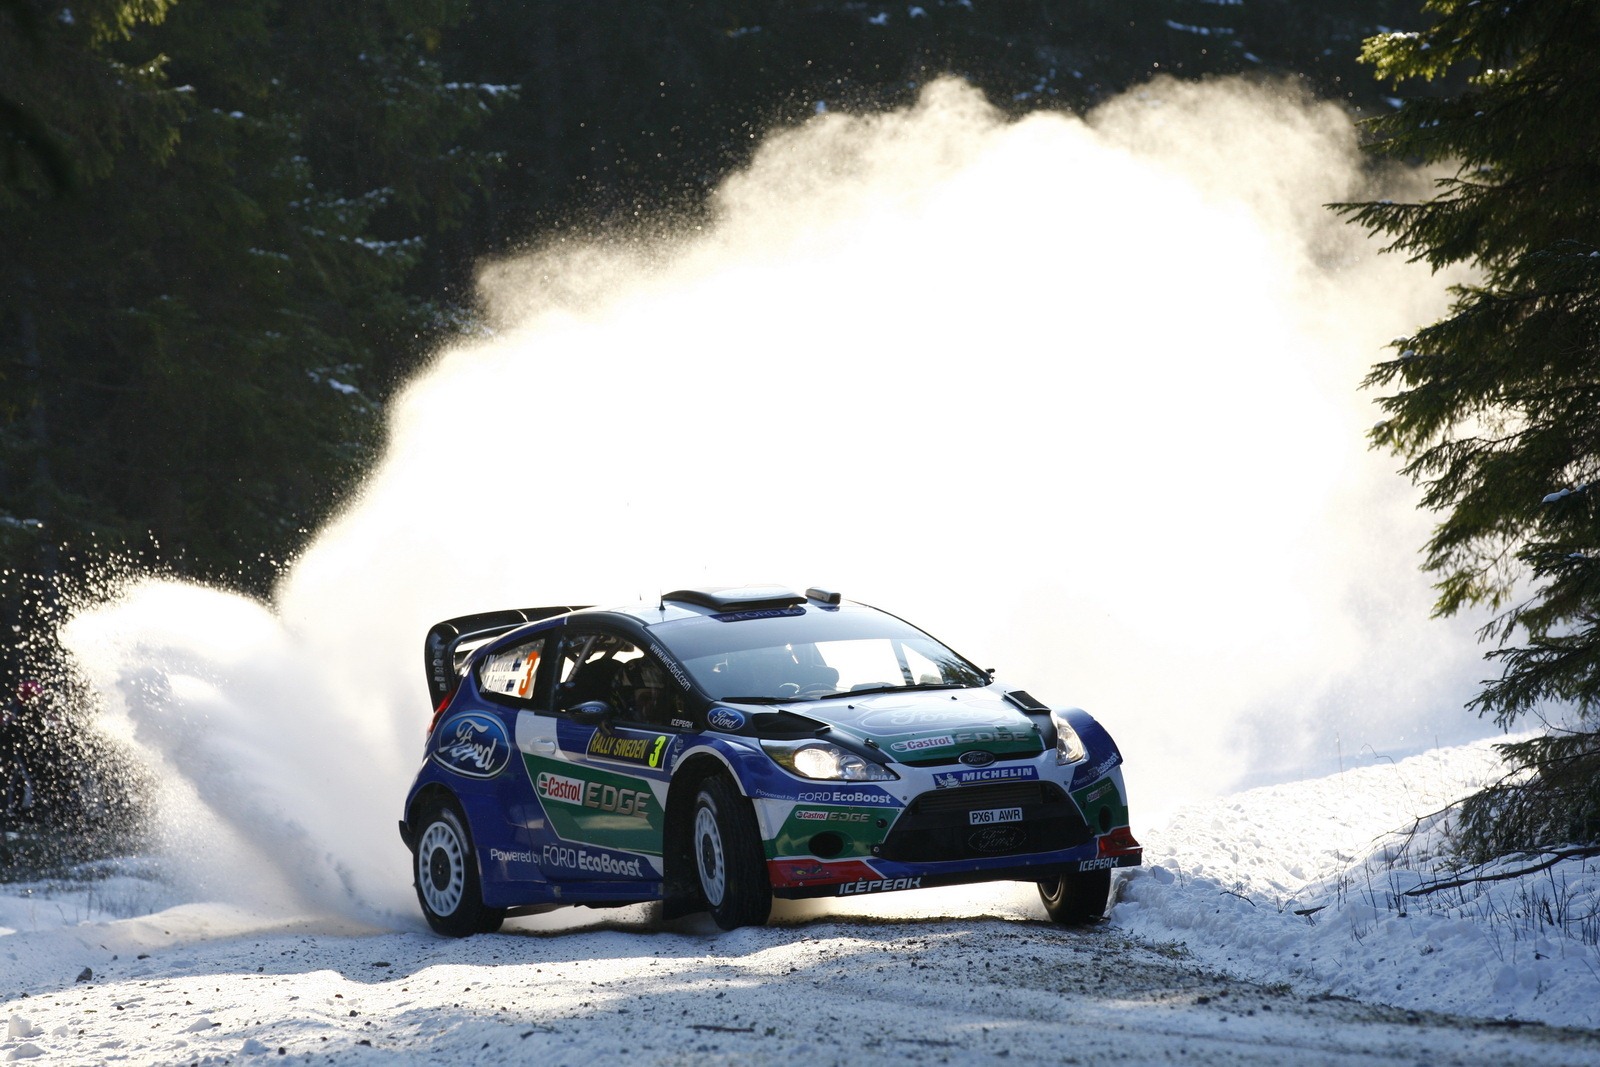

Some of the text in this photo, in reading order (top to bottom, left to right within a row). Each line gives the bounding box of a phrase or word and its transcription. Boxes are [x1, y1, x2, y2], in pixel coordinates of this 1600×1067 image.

[518, 651, 539, 696] 3
[650, 643, 692, 692] www.wrcford.com
[671, 718, 694, 729] ICEPEAK
[712, 709, 739, 729] Ford
[439, 719, 497, 771] Ford
[590, 732, 612, 754] RALLY
[613, 738, 650, 759] SWEDEN
[907, 731, 1030, 750] Castrol EDGE
[648, 735, 667, 767] 3
[962, 767, 1033, 782] MICHELIN
[547, 777, 651, 819] Castrol EDGE
[755, 788, 786, 799] Powered
[797, 792, 831, 802] FORD
[832, 792, 891, 804] EcoBoost
[802, 811, 871, 823] Castrol EDGE
[972, 809, 1021, 823] PX61 AWR
[490, 845, 643, 877] Powered by FORD EcoBoost
[1079, 857, 1119, 872] ICEPEAK
[839, 877, 921, 895] ICEPEAK
